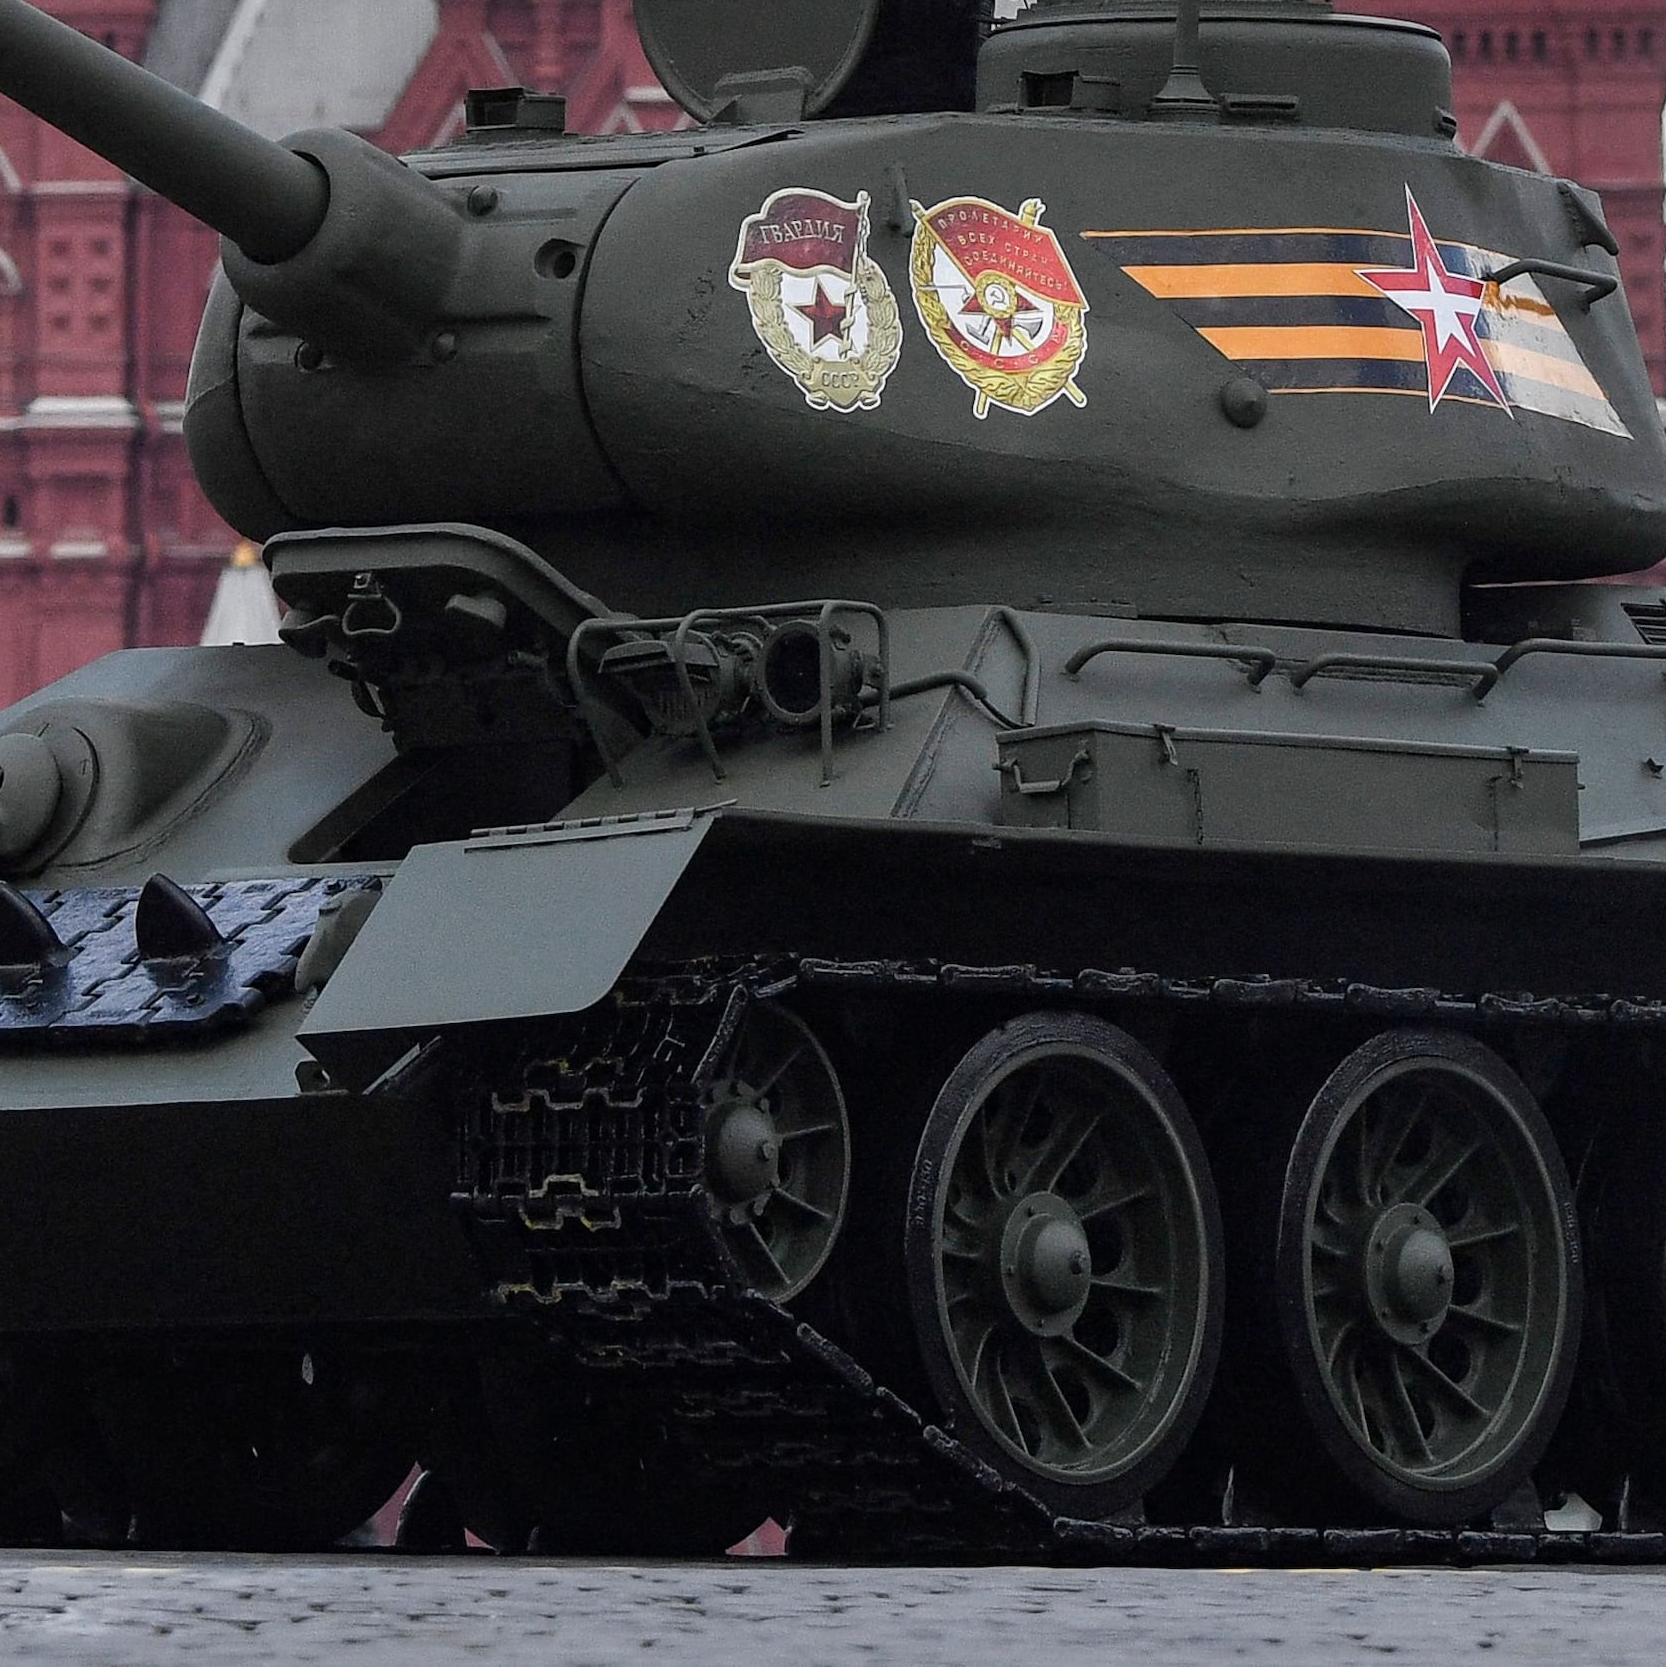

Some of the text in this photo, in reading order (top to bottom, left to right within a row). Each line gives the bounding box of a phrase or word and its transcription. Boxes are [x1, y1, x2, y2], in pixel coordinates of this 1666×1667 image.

[759, 218, 846, 245] ГВАРДИЯ
[956, 232, 996, 246] ВСЕХ
[821, 371, 860, 389] СССР
